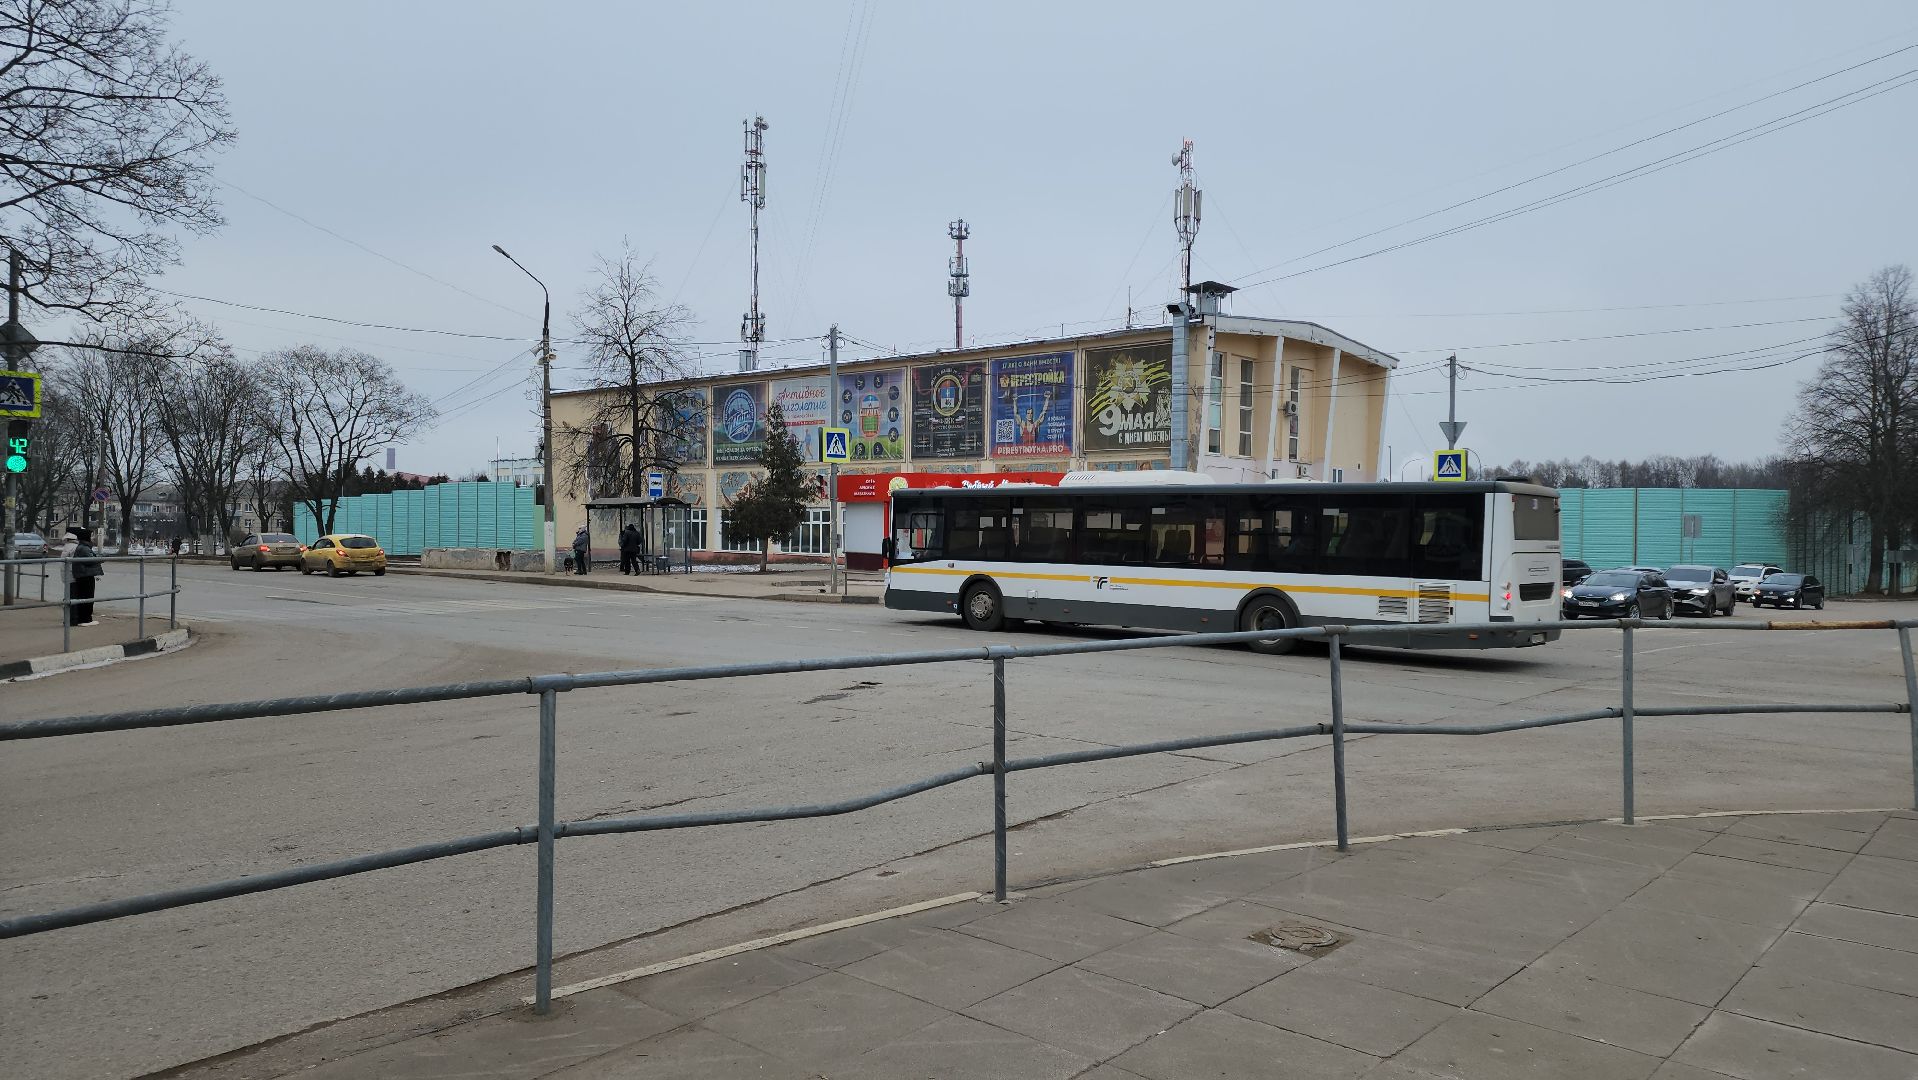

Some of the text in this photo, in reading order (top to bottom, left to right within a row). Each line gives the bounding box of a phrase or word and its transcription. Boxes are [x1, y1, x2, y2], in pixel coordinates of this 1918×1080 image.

[1010, 369, 1065, 387] ПЕРЕСТРОЙКА
[1098, 403, 1154, 436] 9 МАЯ
[1143, 430, 1171, 443] ПОБЕДЫ
[9, 438, 27, 454] 42
